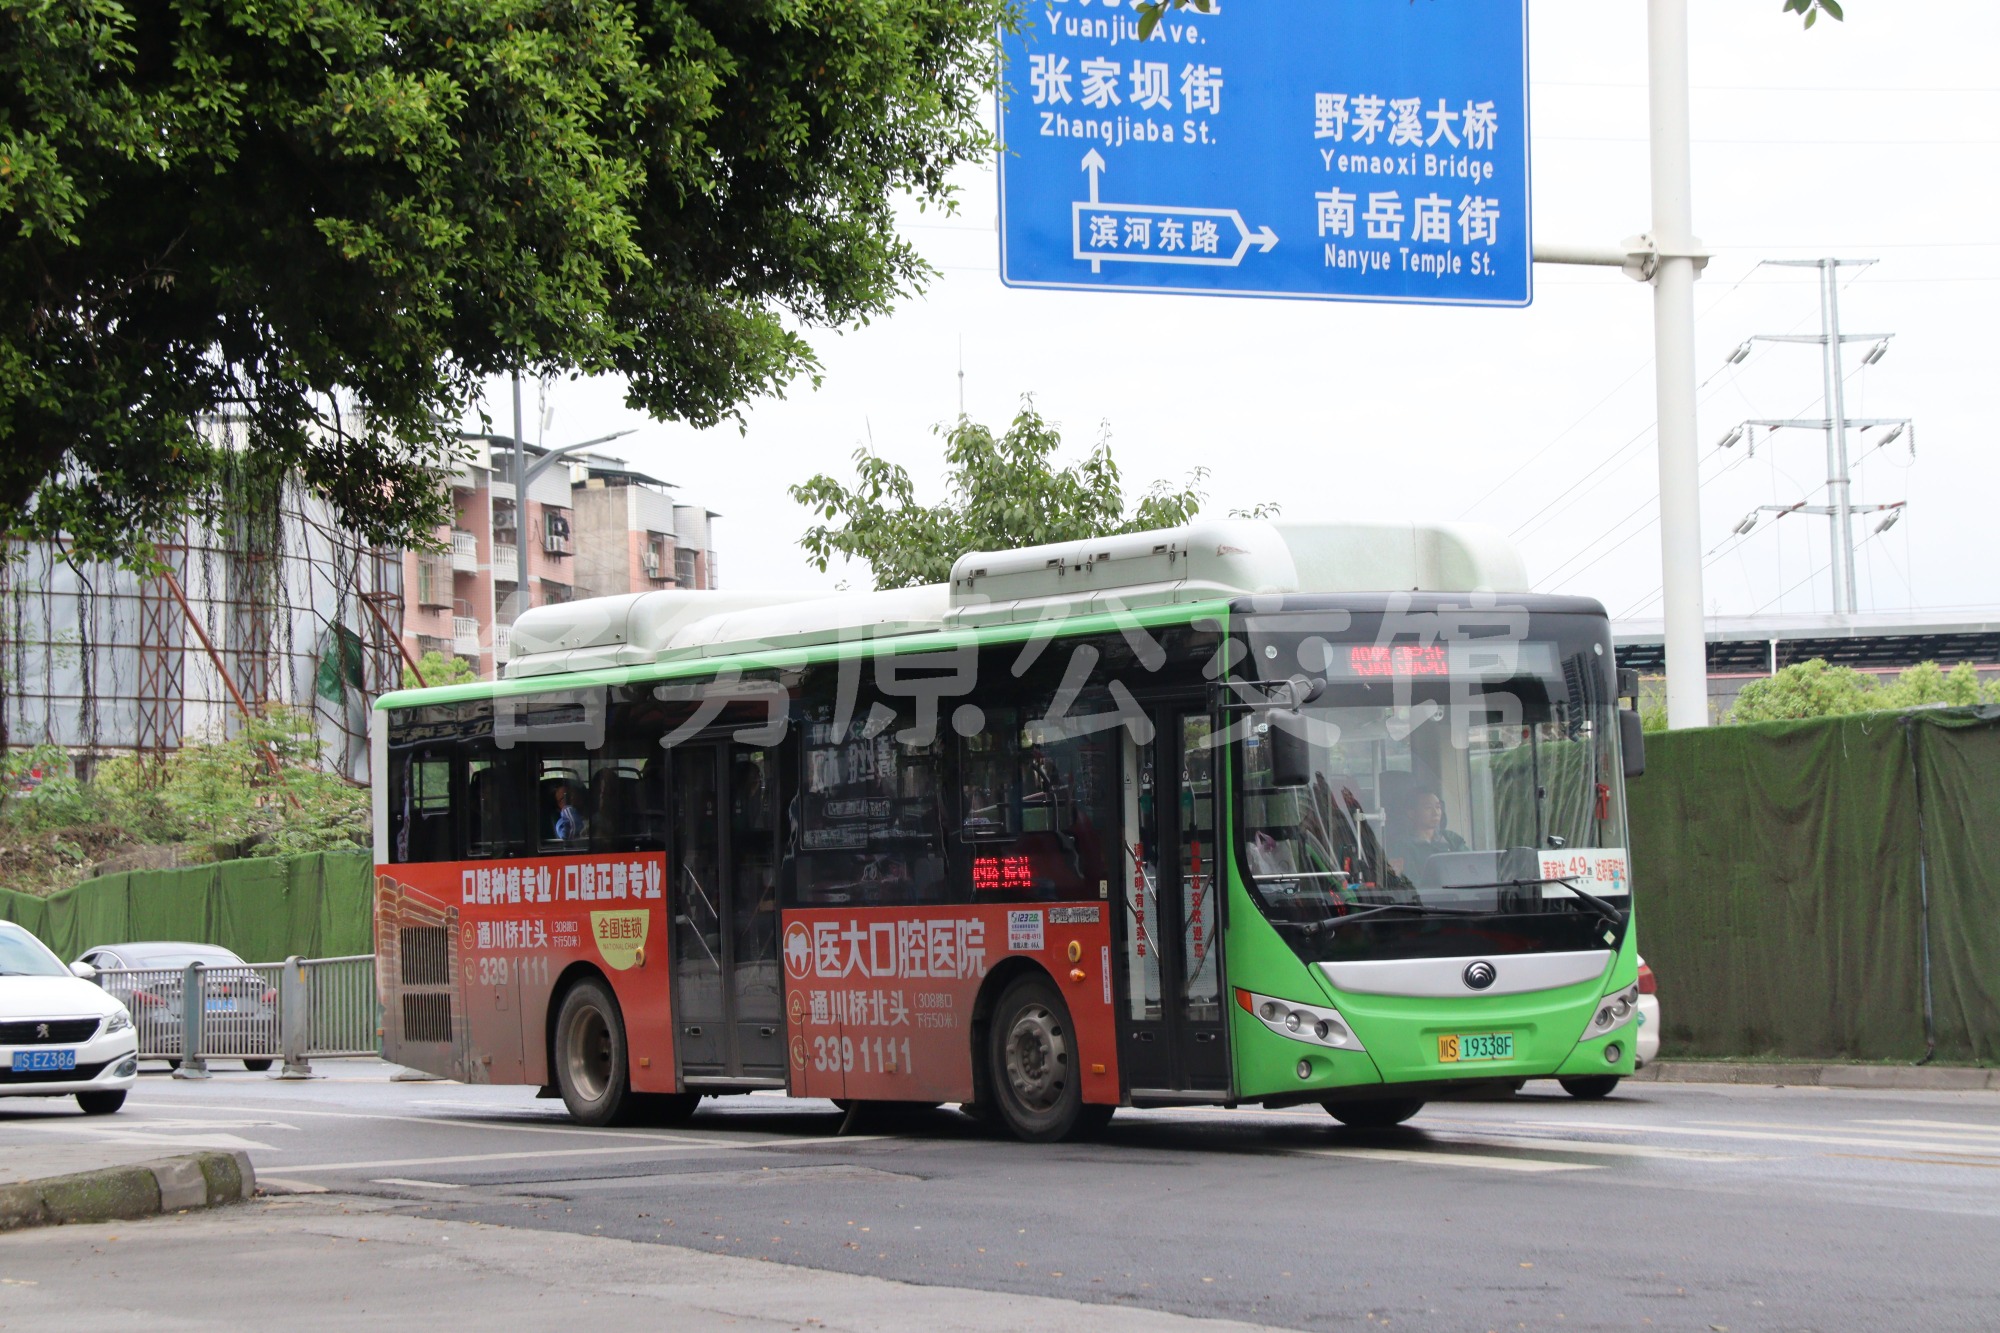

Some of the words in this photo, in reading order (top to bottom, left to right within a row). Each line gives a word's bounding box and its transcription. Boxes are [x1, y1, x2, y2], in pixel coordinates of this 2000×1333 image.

[1045, 10, 1140, 46] Yuanjiu
[1149, 19, 1206, 44] Ave.
[1029, 53, 1224, 115] 张家坝街
[1040, 111, 1174, 147] Zhangjiaba
[1183, 120, 1216, 145] St.
[1314, 92, 1499, 150] 野茅溪大桥
[1320, 148, 1416, 176] Yemaoxi
[1424, 153, 1494, 185] Bridge
[1089, 214, 1220, 254] 滨河东路
[1314, 186, 1501, 246] 南岳庙街
[1324, 243, 1391, 275] Nanyue
[1399, 246, 1462, 279] Temple
[1470, 250, 1496, 277] St.
[461, 865, 552, 905] 口腔种植专业
[564, 860, 662, 902] 口腔正畸专业
[477, 919, 548, 950] 通川桥北头
[598, 917, 643, 940] 全国连锁
[1017, 913, 1039, 922] 12328
[813, 917, 988, 981] 医大口腔医院
[479, 956, 508, 986] 339
[513, 956, 549, 985] 1111
[809, 989, 910, 1027] 通川桥北头
[814, 1036, 854, 1073] 339
[859, 1036, 912, 1075] 1111
[1464, 1034, 1512, 1058] 19338F
